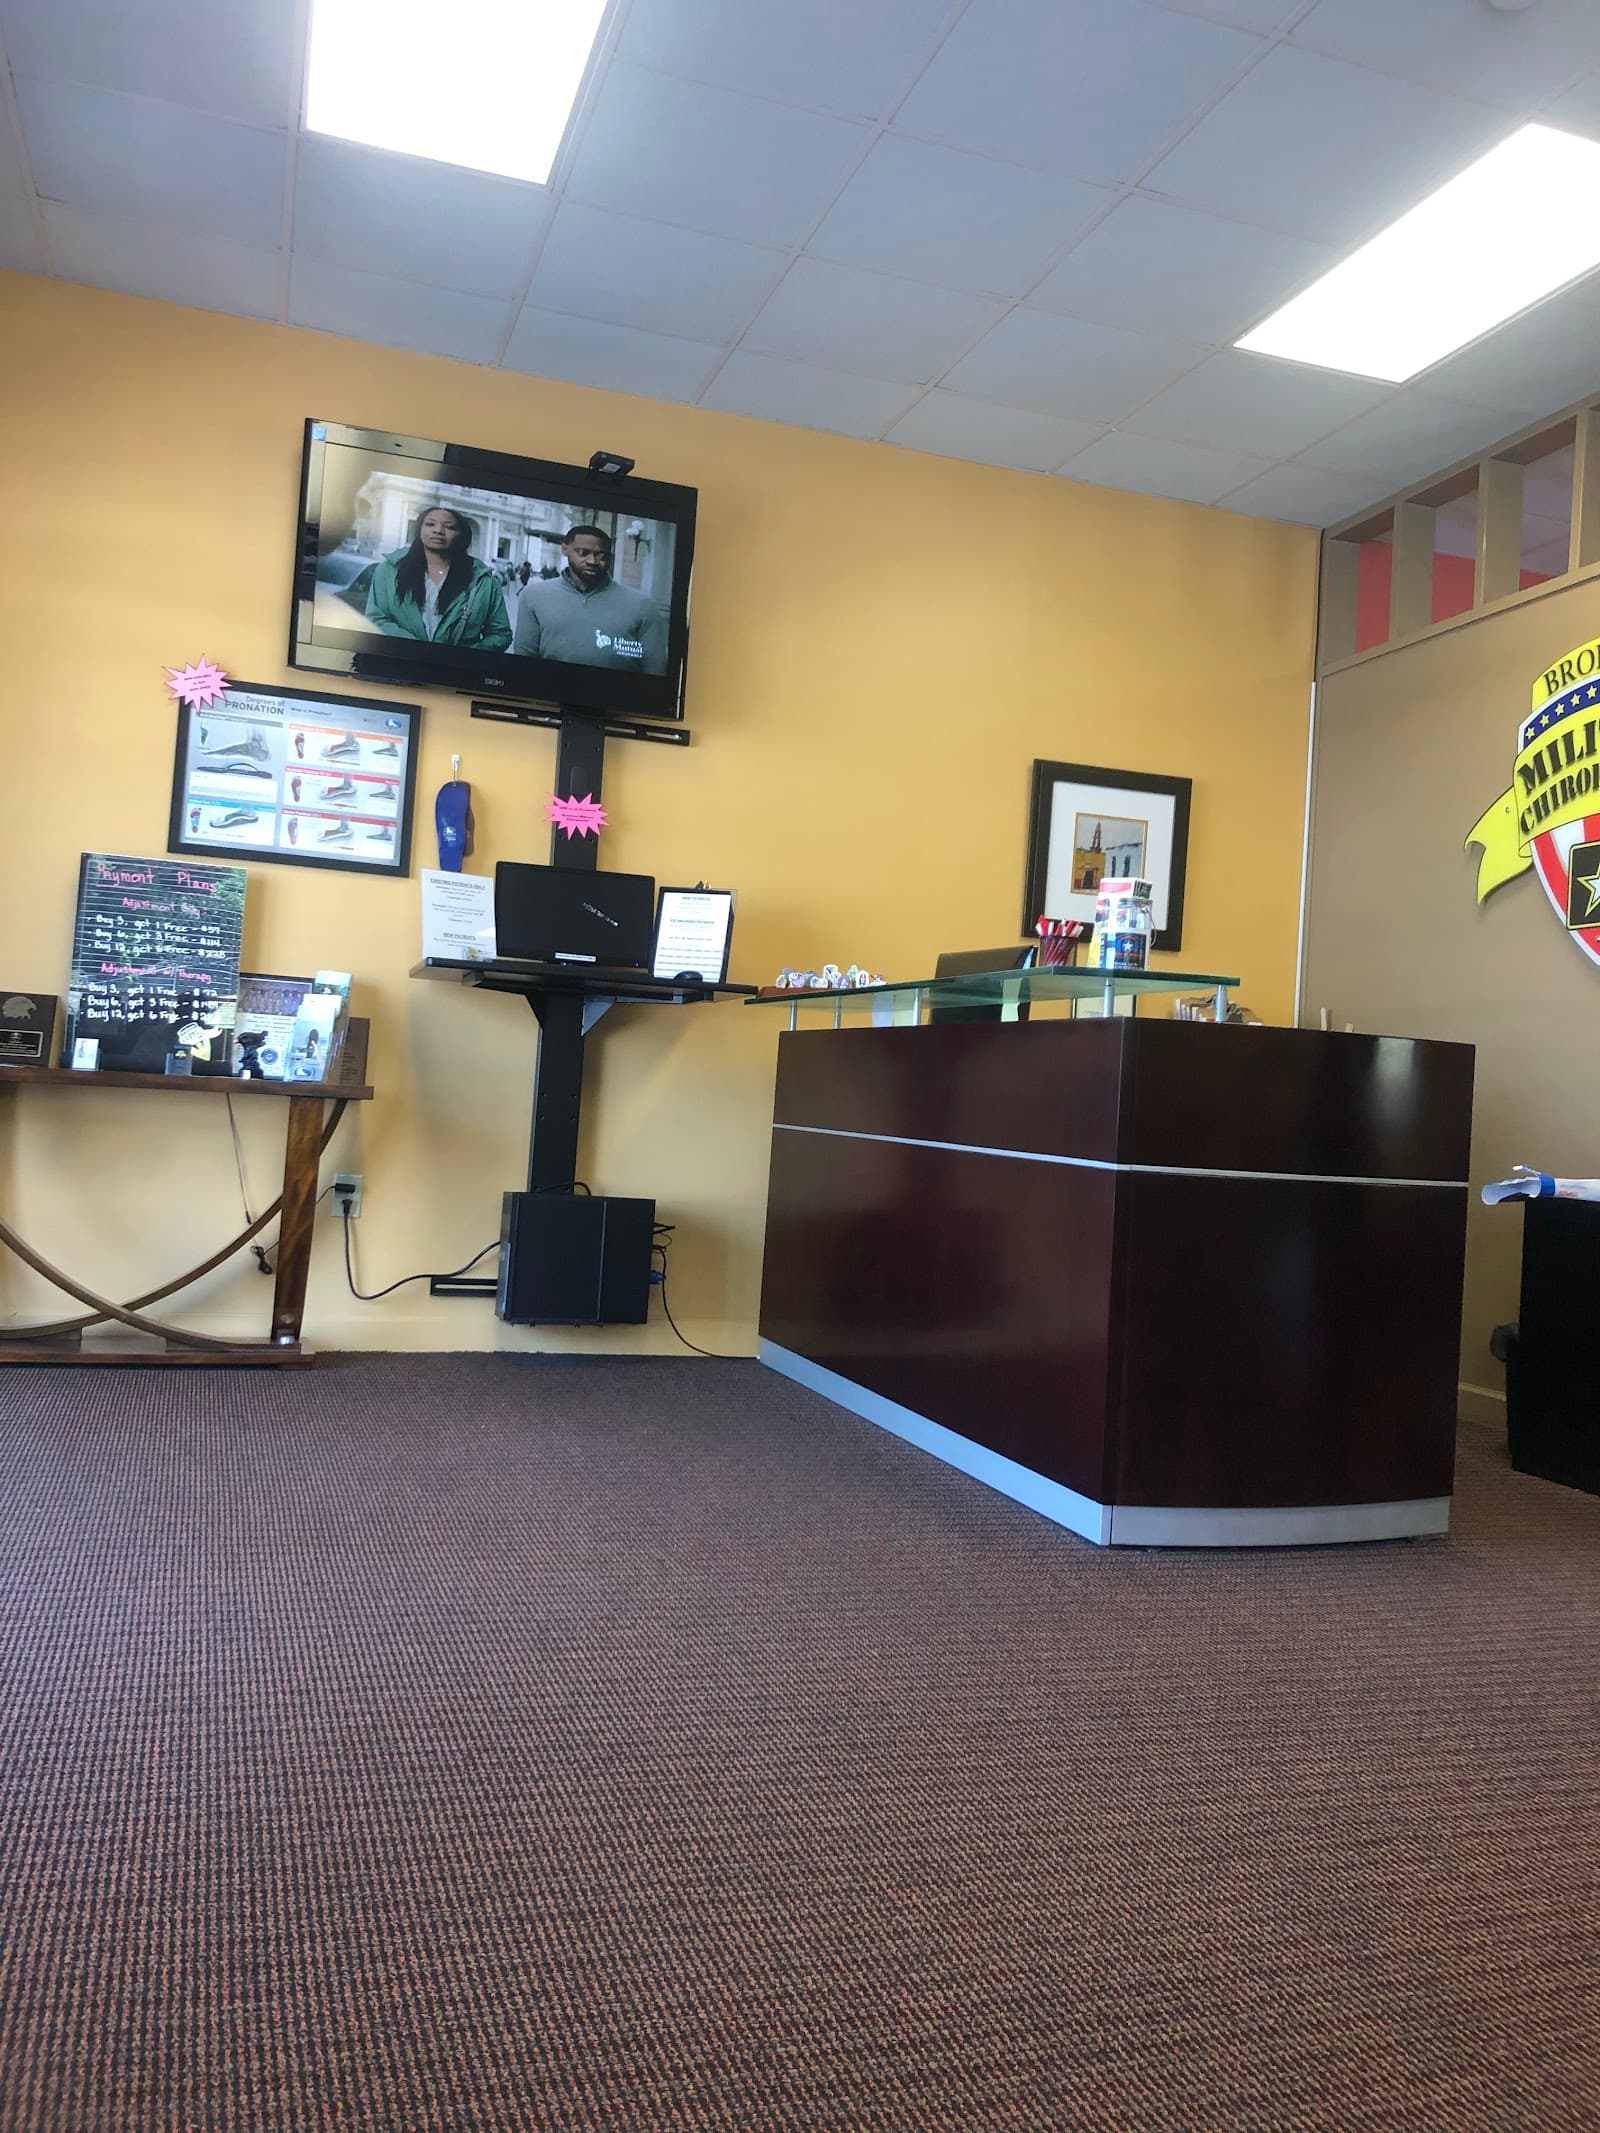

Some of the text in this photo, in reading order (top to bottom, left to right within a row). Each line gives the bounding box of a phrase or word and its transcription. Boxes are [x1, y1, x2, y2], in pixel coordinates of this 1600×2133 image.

[613, 644, 643, 653] Mutual
[614, 637, 642, 647] Liberty
[225, 700, 285, 715] PRONATION
[246, 695, 278, 706] Degrees
[1517, 719, 1600, 797] MILI
[97, 863, 218, 892] Payment Plans
[122, 897, 176, 912] Adjustment
[96, 915, 113, 928] Buy
[134, 919, 151, 929] get
[164, 922, 188, 932] Free
[95, 929, 112, 941] Buy
[134, 933, 151, 943] get
[164, 933, 189, 943] Free
[94, 941, 111, 953] Buy
[133, 945, 152, 957] get
[164, 946, 191, 954] Free
[100, 962, 157, 976] Adjustment
[178, 969, 212, 984] Therapy
[89, 982, 107, 995] Buy
[127, 985, 145, 997] get
[157, 986, 178, 996] Free
[87, 995, 109, 1010] Buy
[128, 998, 145, 1010] get
[159, 999, 180, 1010] Free
[87, 1009, 109, 1022] Buy
[127, 1011, 145, 1022] get
[160, 1012, 181, 1024] Free
